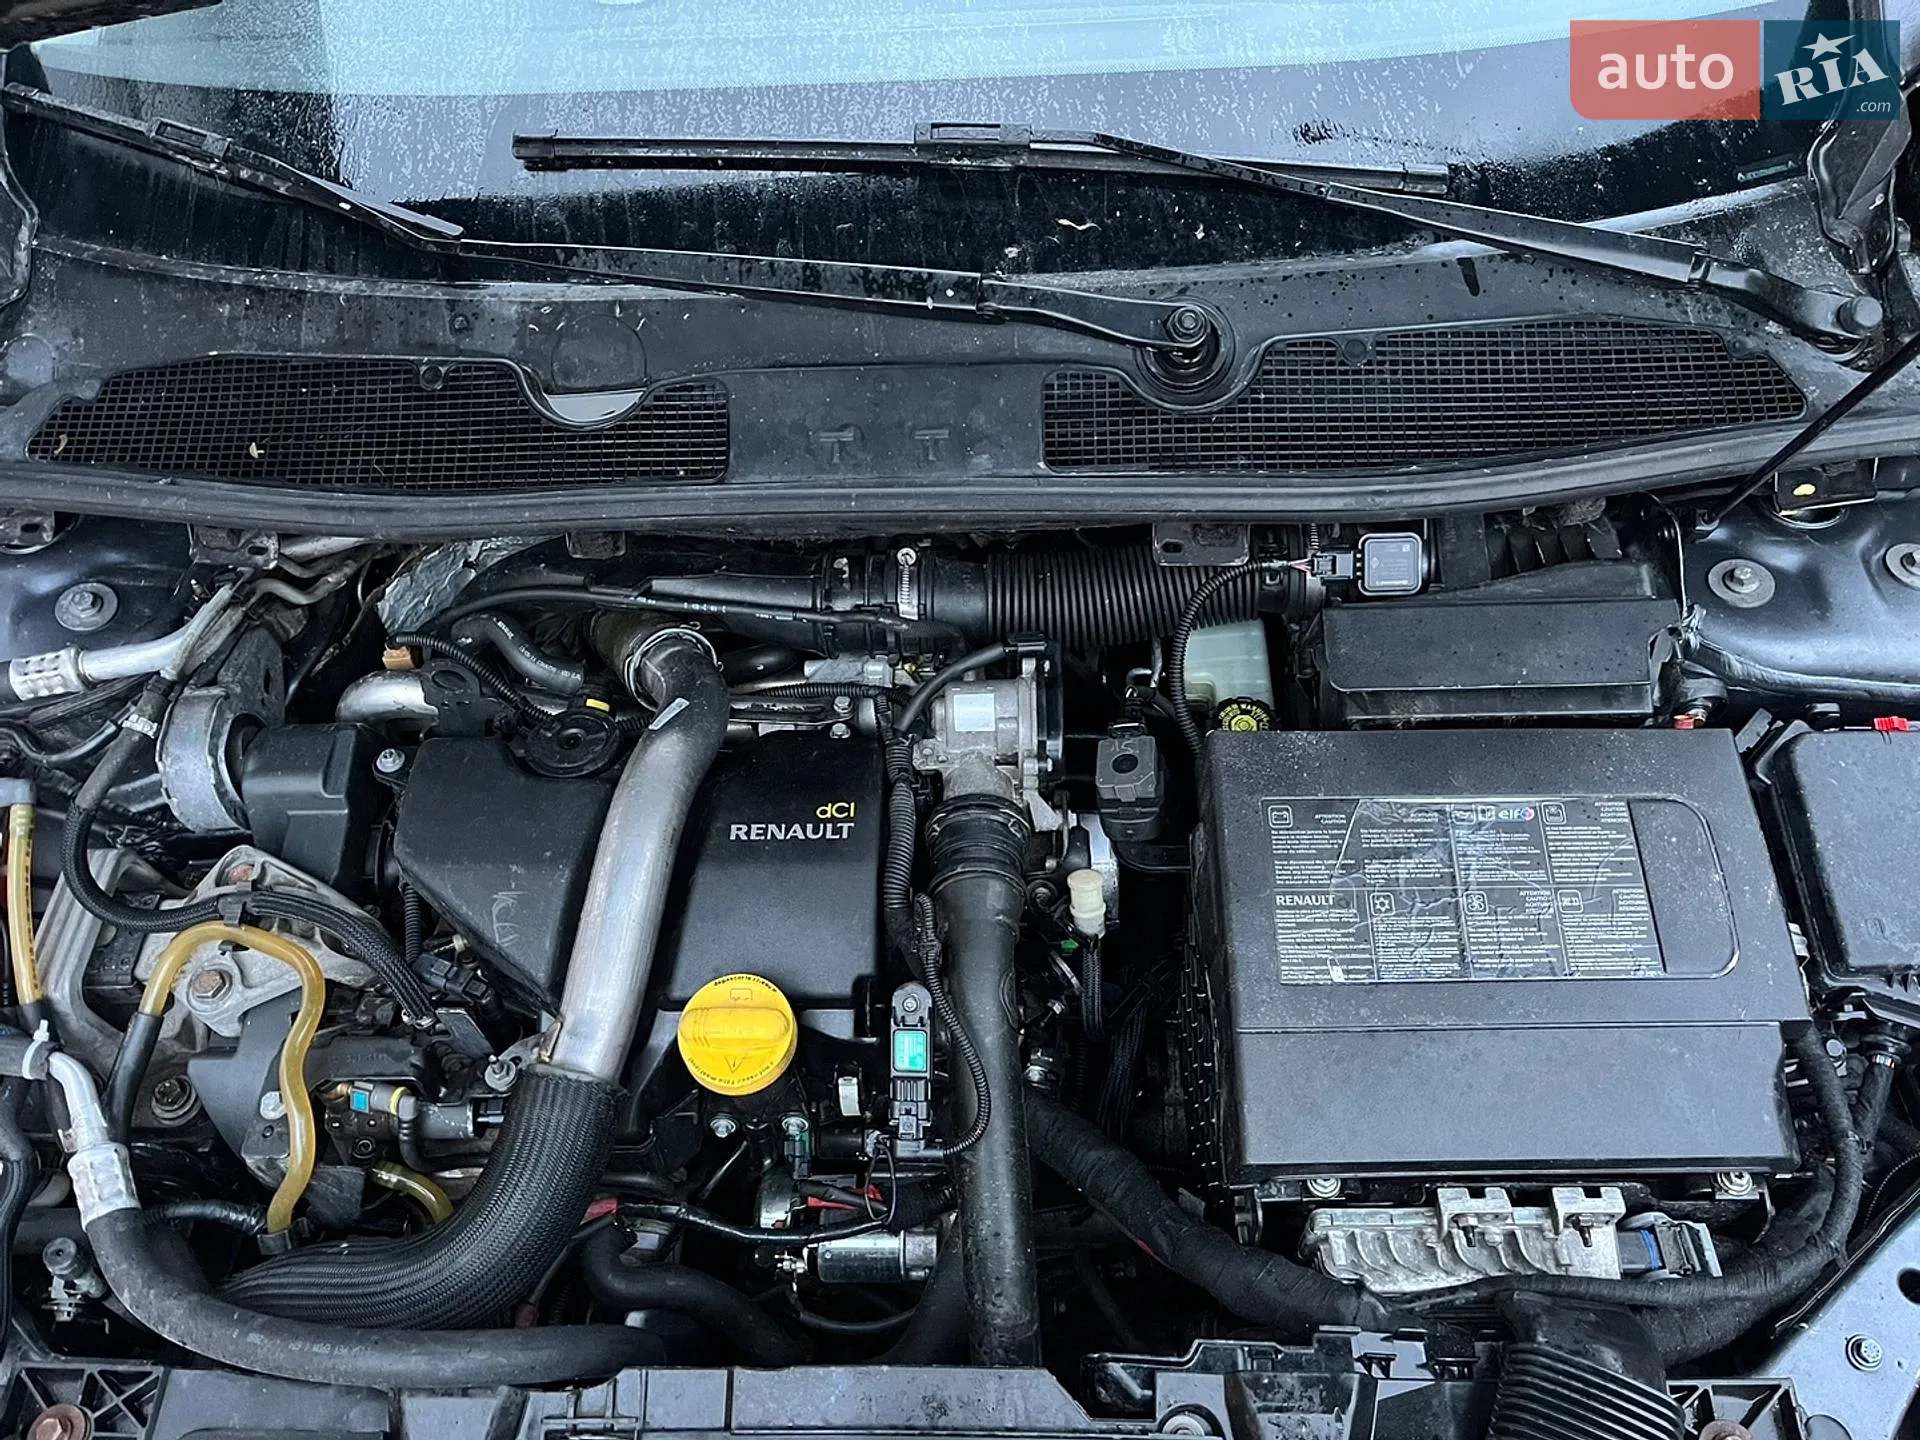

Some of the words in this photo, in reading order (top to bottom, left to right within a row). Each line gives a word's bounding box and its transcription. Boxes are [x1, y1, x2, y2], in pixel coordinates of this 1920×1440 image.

[1498, 808, 1521, 820] elf
[729, 822, 855, 840] RENAULT
[1275, 894, 1336, 906] RENAULT
